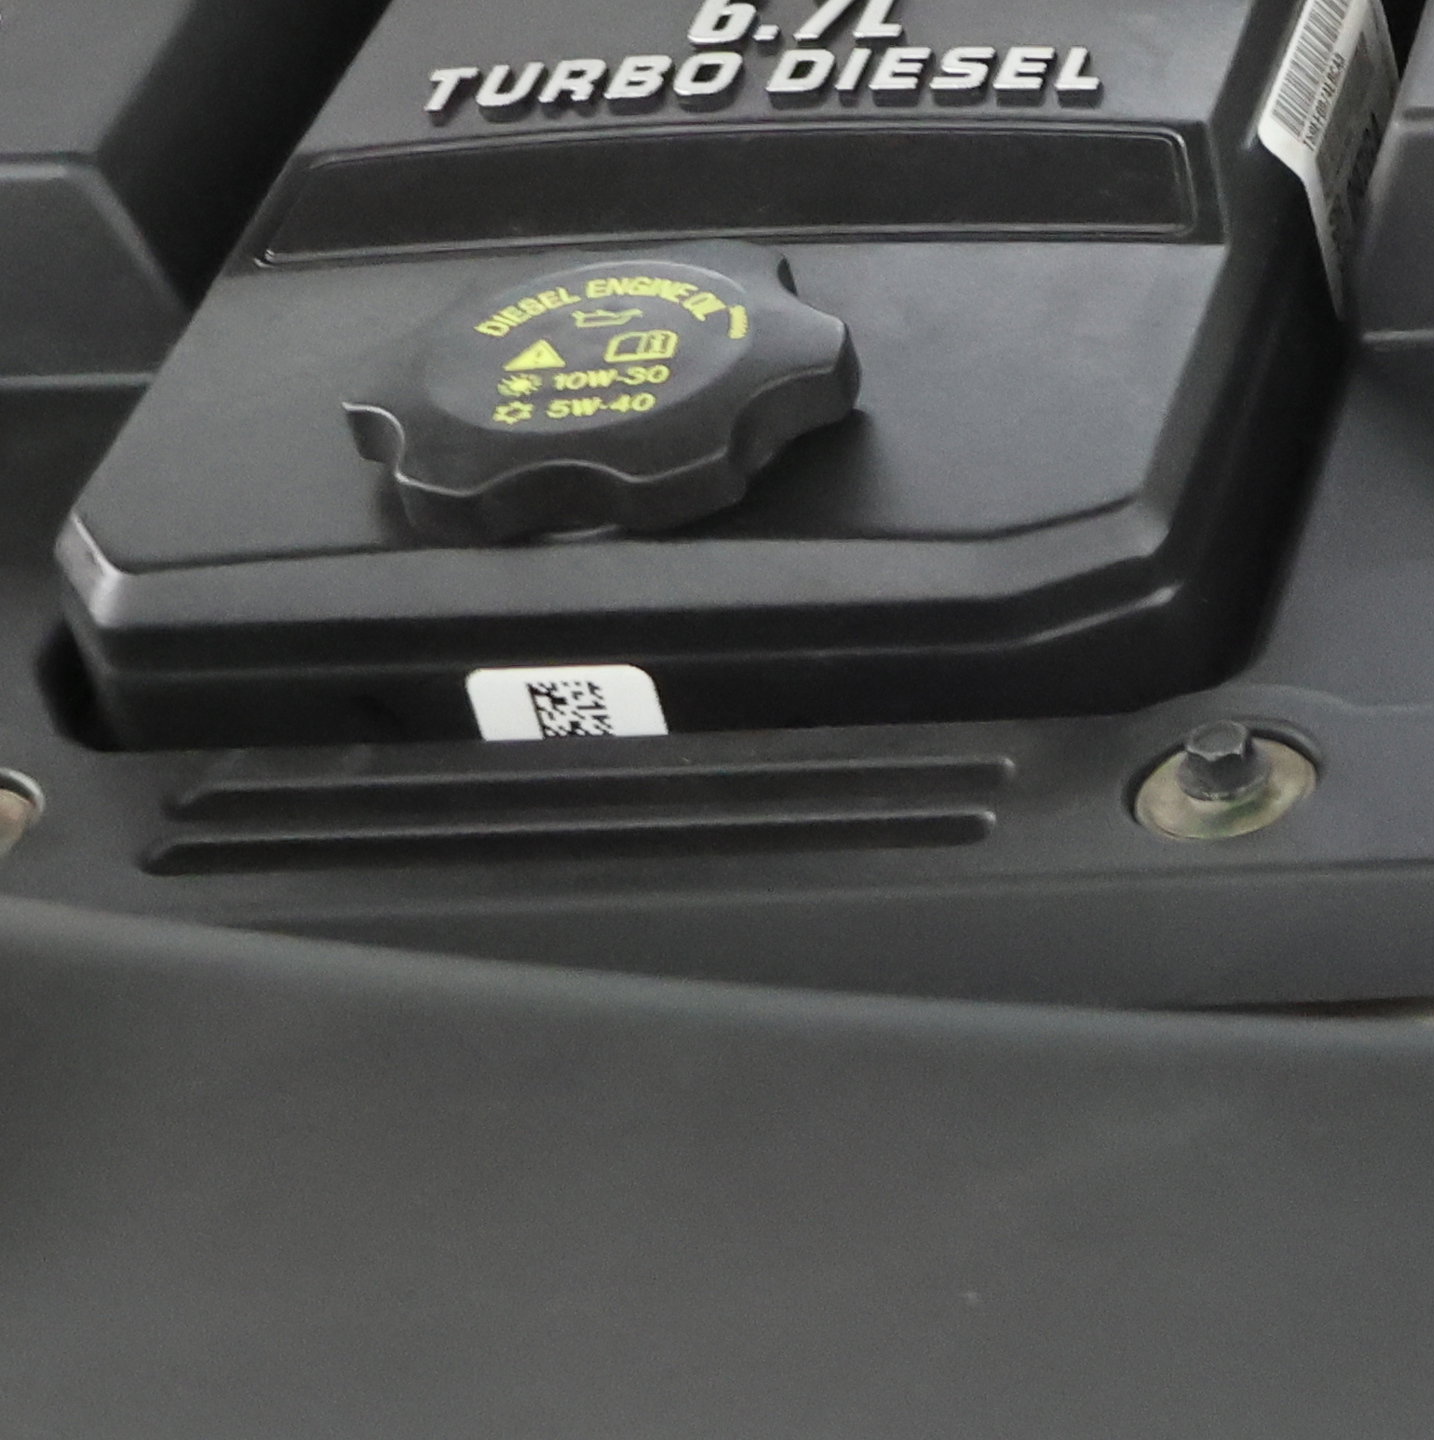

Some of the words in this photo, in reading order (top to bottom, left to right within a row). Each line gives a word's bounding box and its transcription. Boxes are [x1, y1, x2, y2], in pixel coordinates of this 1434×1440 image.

[424, 52, 744, 114] TURBO
[766, 46, 1101, 92] DIESEL
[474, 286, 582, 338] DIESEL
[585, 276, 702, 305] ENGINE
[688, 289, 728, 322] OIL
[553, 364, 670, 391] 10W-30
[545, 392, 656, 420] 5W-40
